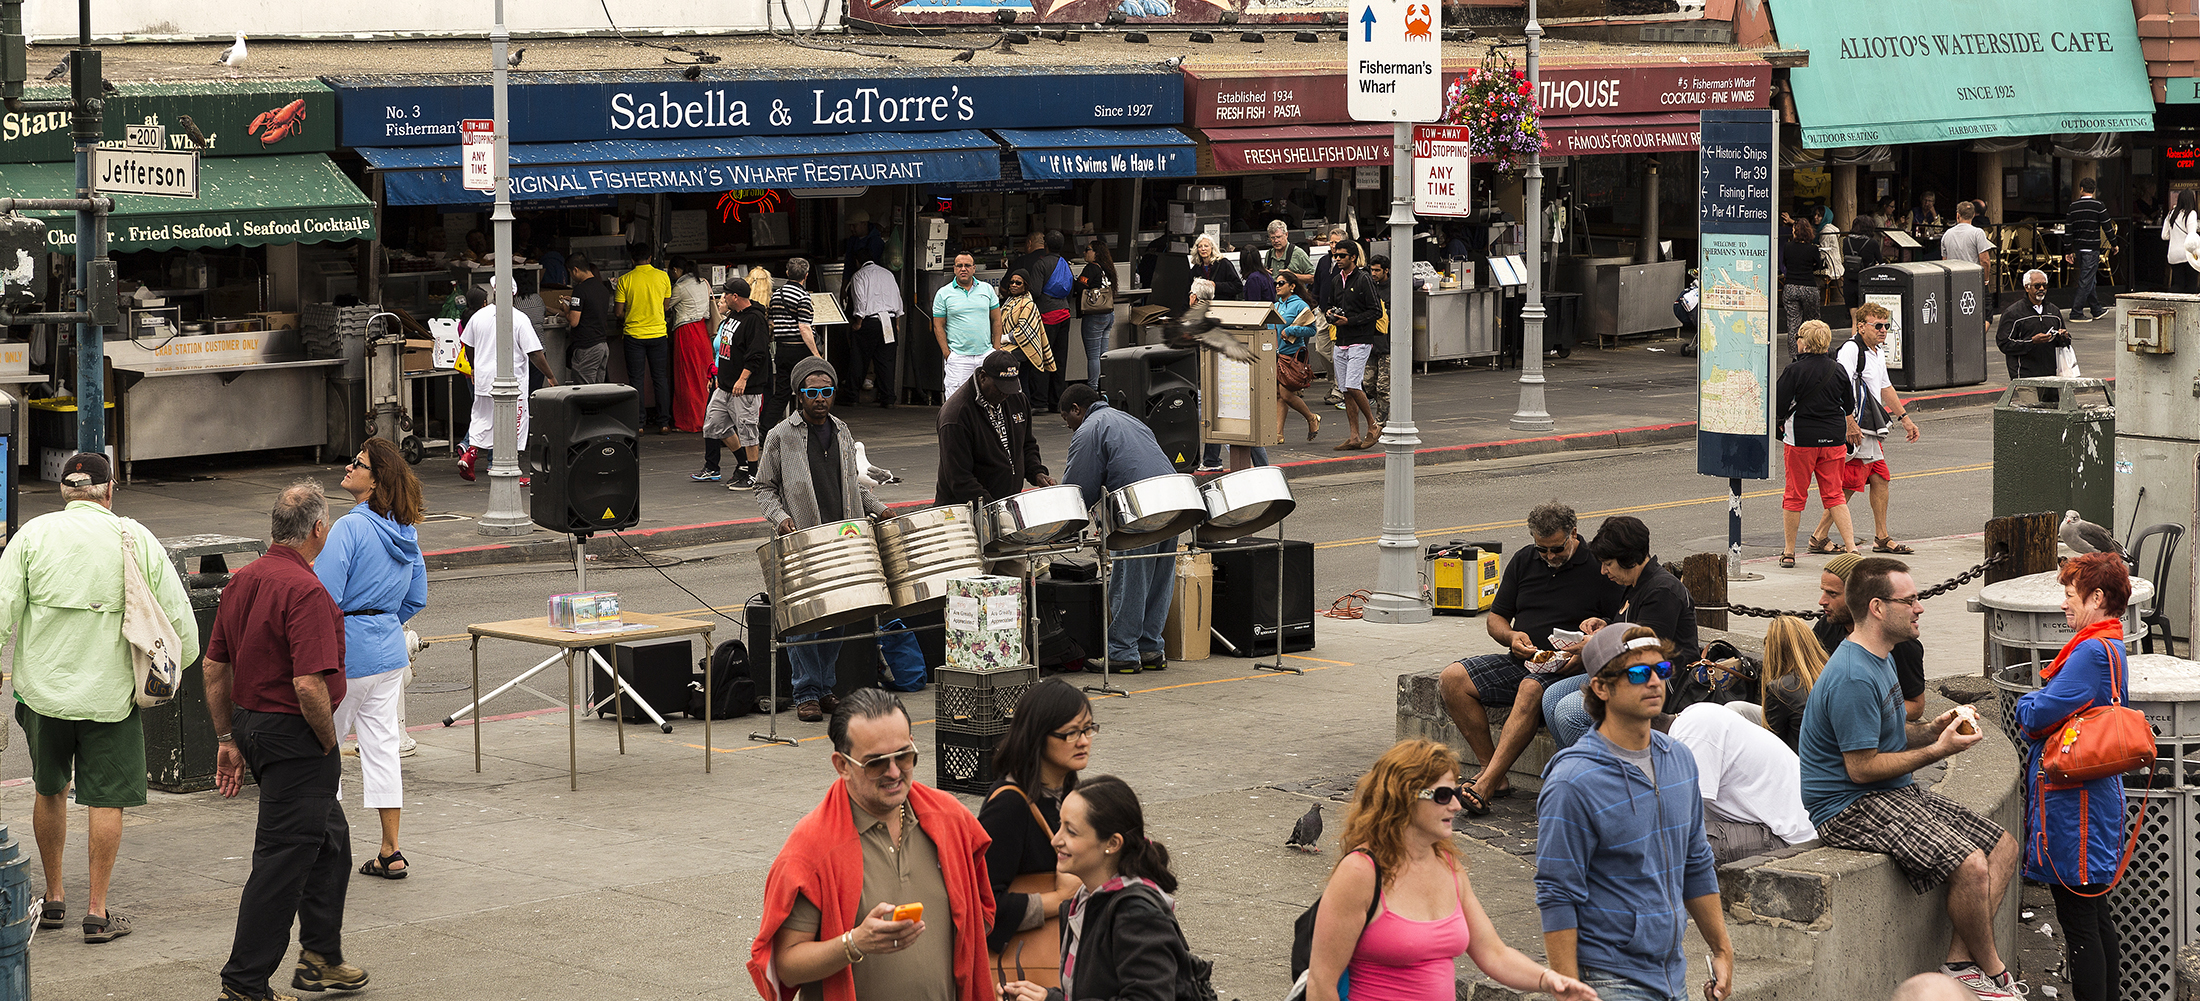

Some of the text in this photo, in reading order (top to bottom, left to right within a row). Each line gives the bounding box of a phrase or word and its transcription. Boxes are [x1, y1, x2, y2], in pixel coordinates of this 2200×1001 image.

[1840, 31, 2114, 60] ALIOTO'S WATERSIDE CAFE
[1359, 60, 1432, 75] Fisherman's
[1359, 79, 1395, 94] Wharf
[1678, 77, 1756, 90] #5 Fisherman's Wharf
[1217, 90, 1293, 104] Established 1934
[1539, 79, 1620, 109] THOUSE
[1660, 90, 1755, 105] COCKTAILS FINE WINES
[1957, 85, 2016, 101] SINCE 1925
[385, 105, 421, 118] No. 3
[610, 85, 974, 130] Sabella & LaTorre's
[1094, 104, 1153, 118] Since 1927
[1216, 105, 1301, 120] FRESH FISH PASTA
[2, 111, 73, 142] Stati
[144, 113, 159, 126] at
[2061, 117, 2148, 129] OUTDOOR SEATING
[385, 121, 463, 136] Fisherman's
[1421, 128, 1461, 139] TOW-AWAY
[1948, 124, 1999, 136] HARBOR VIEW
[137, 129, 157, 146] 200
[463, 131, 494, 145] NO STOPPING
[1567, 135, 1610, 150] FAMOUS
[1611, 134, 1632, 149] FOR
[1633, 133, 1655, 148] OUR
[1656, 132, 1689, 147] FAMILY
[1807, 131, 1879, 144] OUTDOOR SEATING
[471, 151, 486, 162] ANY
[1244, 145, 1390, 164] FRESH SHELLFISH DAILY &
[1415, 140, 1467, 158] NO STOPPING
[1715, 145, 1767, 161] Historic Ships
[470, 163, 488, 175] TIME
[1063, 155, 1074, 172] It
[1076, 154, 1108, 173] Swims
[1111, 154, 1127, 172] We
[1130, 154, 1155, 171] Have
[102, 159, 186, 187] Jefferson
[481, 161, 923, 196] RIGINAL FISHERMAN'S WHARF RESTAURANT
[1429, 166, 1453, 179] ANY
[1735, 166, 1768, 180] Pier 39
[1427, 182, 1455, 196] TIME
[1719, 185, 1769, 200] Fishing Fleet
[1712, 203, 1725, 217] Pier
[1726, 204, 1736, 218] 41
[243, 216, 370, 236] Seafood Cocktails
[47, 223, 232, 245] Chor Fried Seafood
[1738, 249, 1768, 257] WHARF
[155, 338, 259, 357] CRAB STATION CUSTOMER ONLY
[4, 351, 23, 363] ONLY
